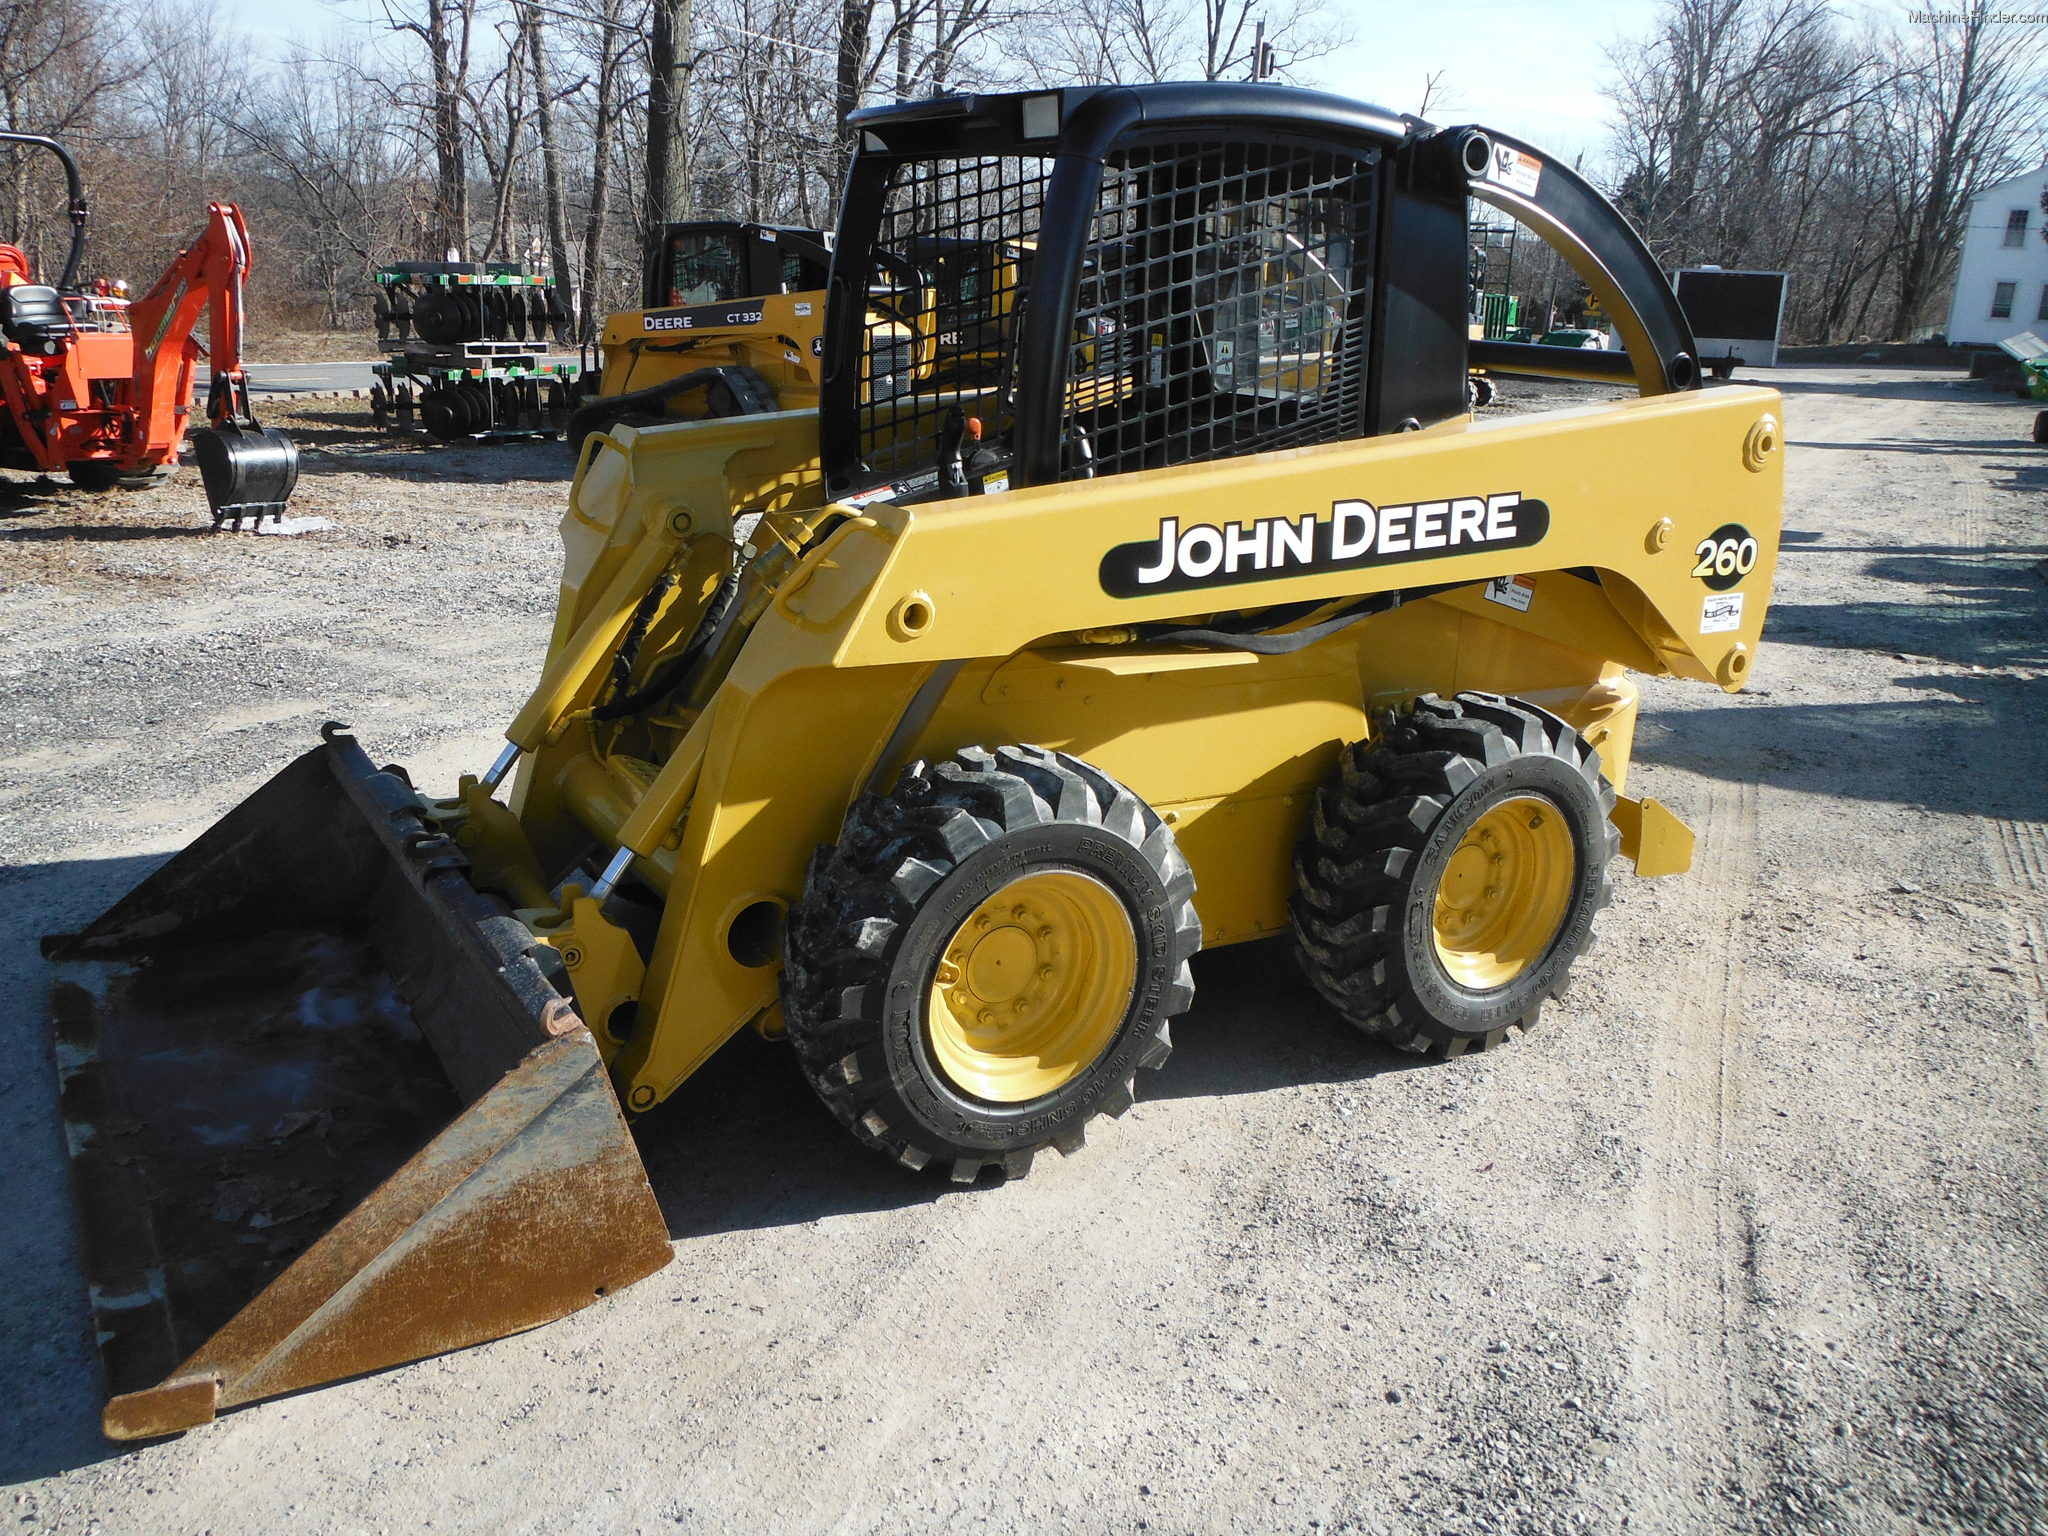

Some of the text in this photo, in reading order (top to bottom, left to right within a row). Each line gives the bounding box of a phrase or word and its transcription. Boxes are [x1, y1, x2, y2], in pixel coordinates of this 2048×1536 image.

[644, 316, 692, 330] DEERE
[727, 312, 763, 323] CT 332
[1138, 494, 1520, 584] JOHN DEERE
[1691, 537, 1758, 577] 260
[1147, 904, 1167, 958] SKID
